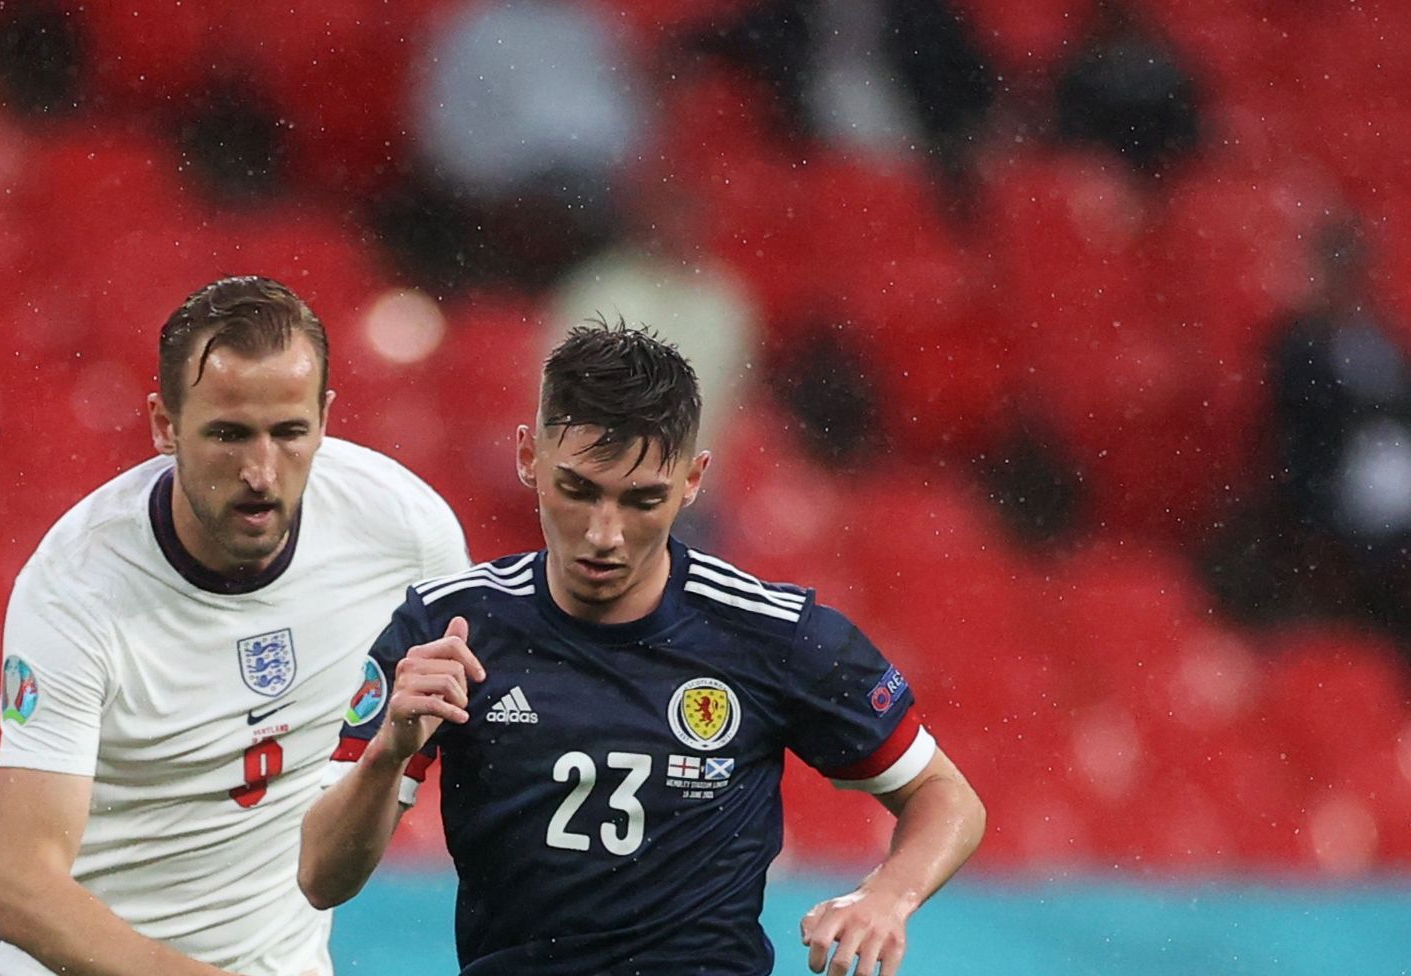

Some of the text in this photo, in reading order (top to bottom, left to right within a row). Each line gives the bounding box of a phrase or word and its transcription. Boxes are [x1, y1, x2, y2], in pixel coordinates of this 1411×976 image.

[486, 708, 539, 724] adidas
[229, 736, 283, 809] 9
[545, 750, 654, 857] 23
